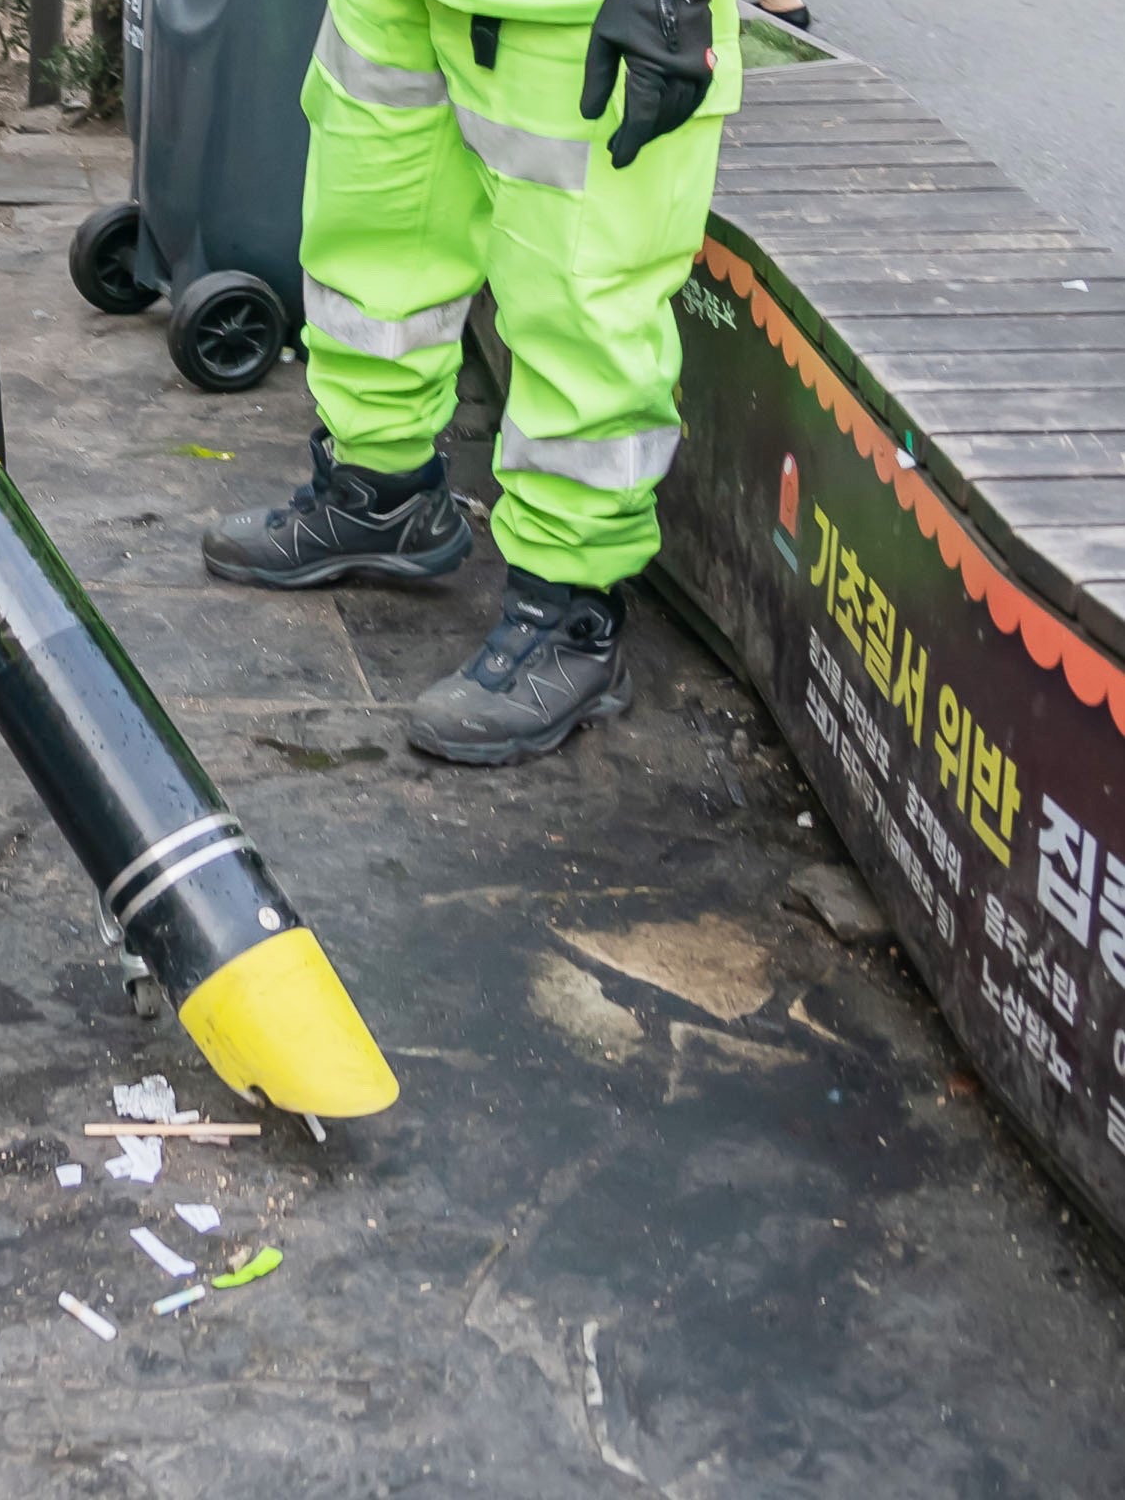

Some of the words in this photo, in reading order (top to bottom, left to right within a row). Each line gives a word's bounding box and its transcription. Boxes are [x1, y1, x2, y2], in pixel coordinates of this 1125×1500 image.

[810, 504, 929, 749] 기초질서
[935, 684, 1022, 869] 위반
[905, 779, 962, 897] 호객행위
[984, 892, 1077, 1027] 음주소란
[981, 954, 1073, 1095] 노상방뇨
